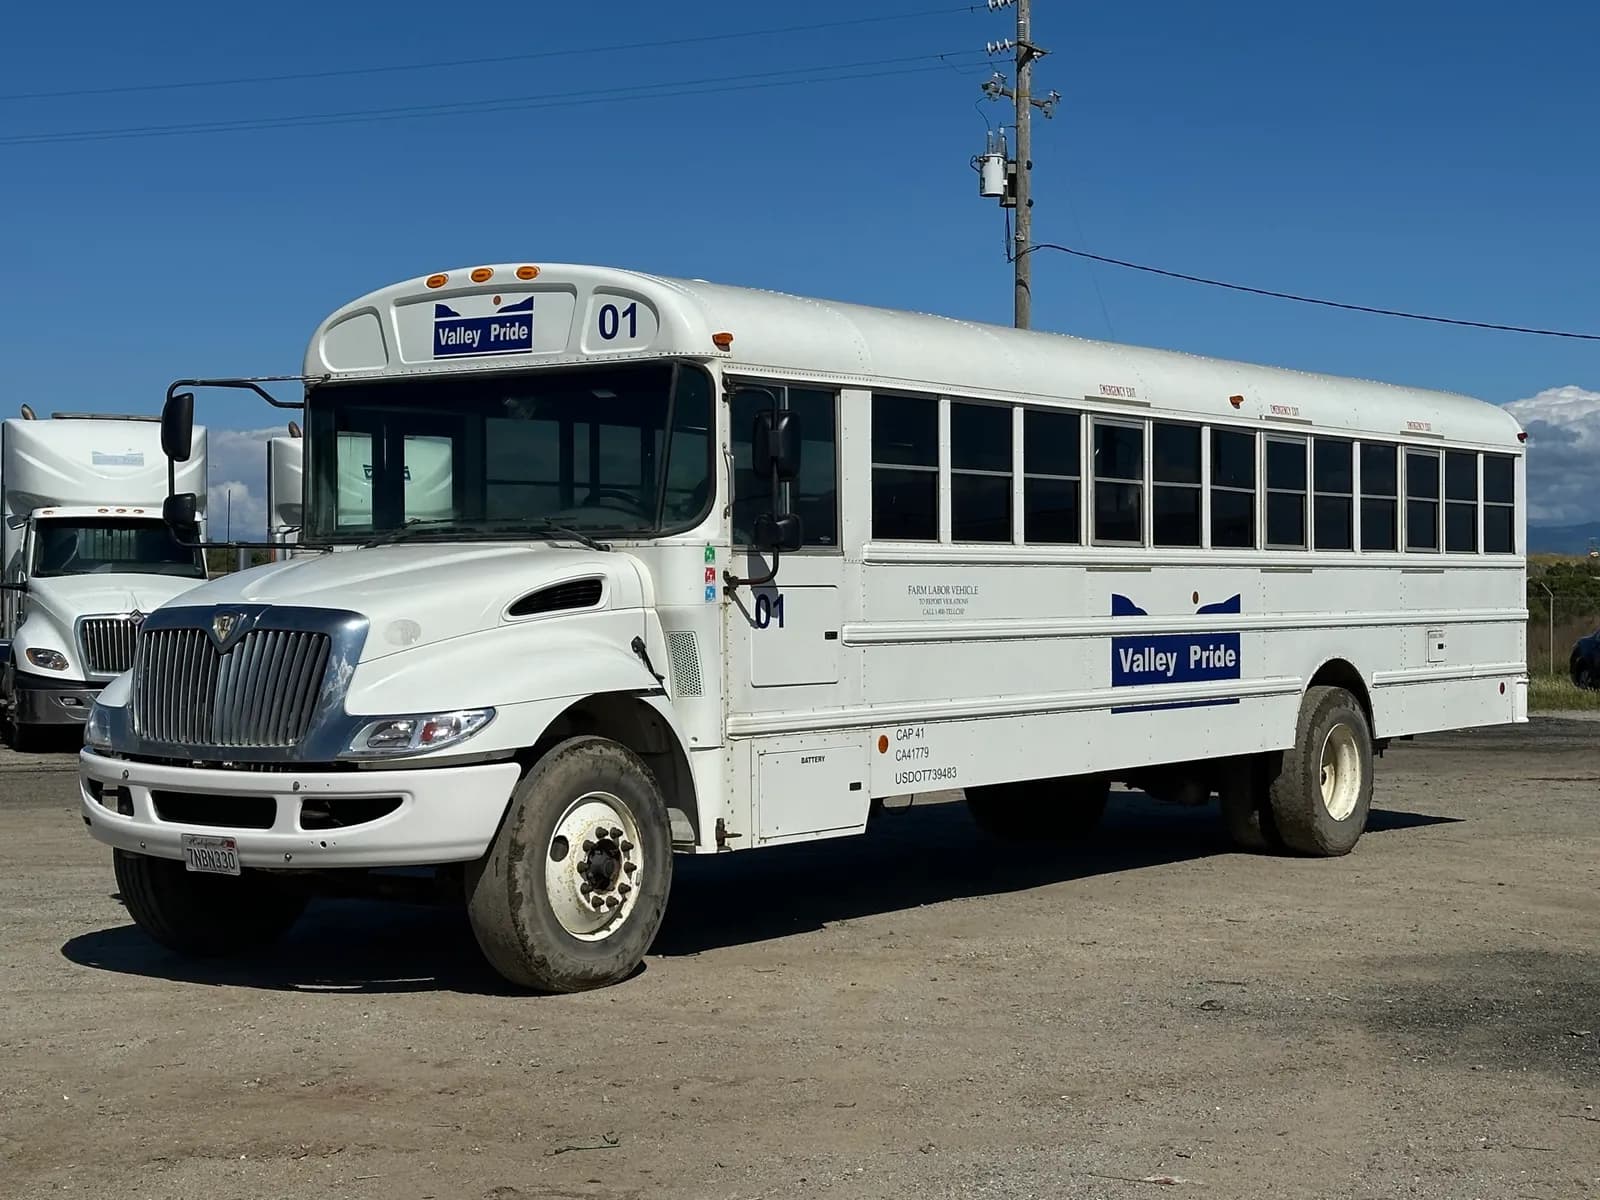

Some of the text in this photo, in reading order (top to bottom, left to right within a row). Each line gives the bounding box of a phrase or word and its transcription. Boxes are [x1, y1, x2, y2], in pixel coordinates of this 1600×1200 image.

[598, 302, 637, 340] 01
[438, 323, 528, 348] Valley Pride
[908, 585, 978, 595] FARM LABOR VEHICLE
[755, 593, 784, 629] 01
[1118, 644, 1236, 677] Valley Pride
[896, 727, 925, 741] CAP 41
[801, 755, 826, 764] BATTERY
[895, 746, 929, 762] CA41779
[895, 766, 957, 784] USDOT739483
